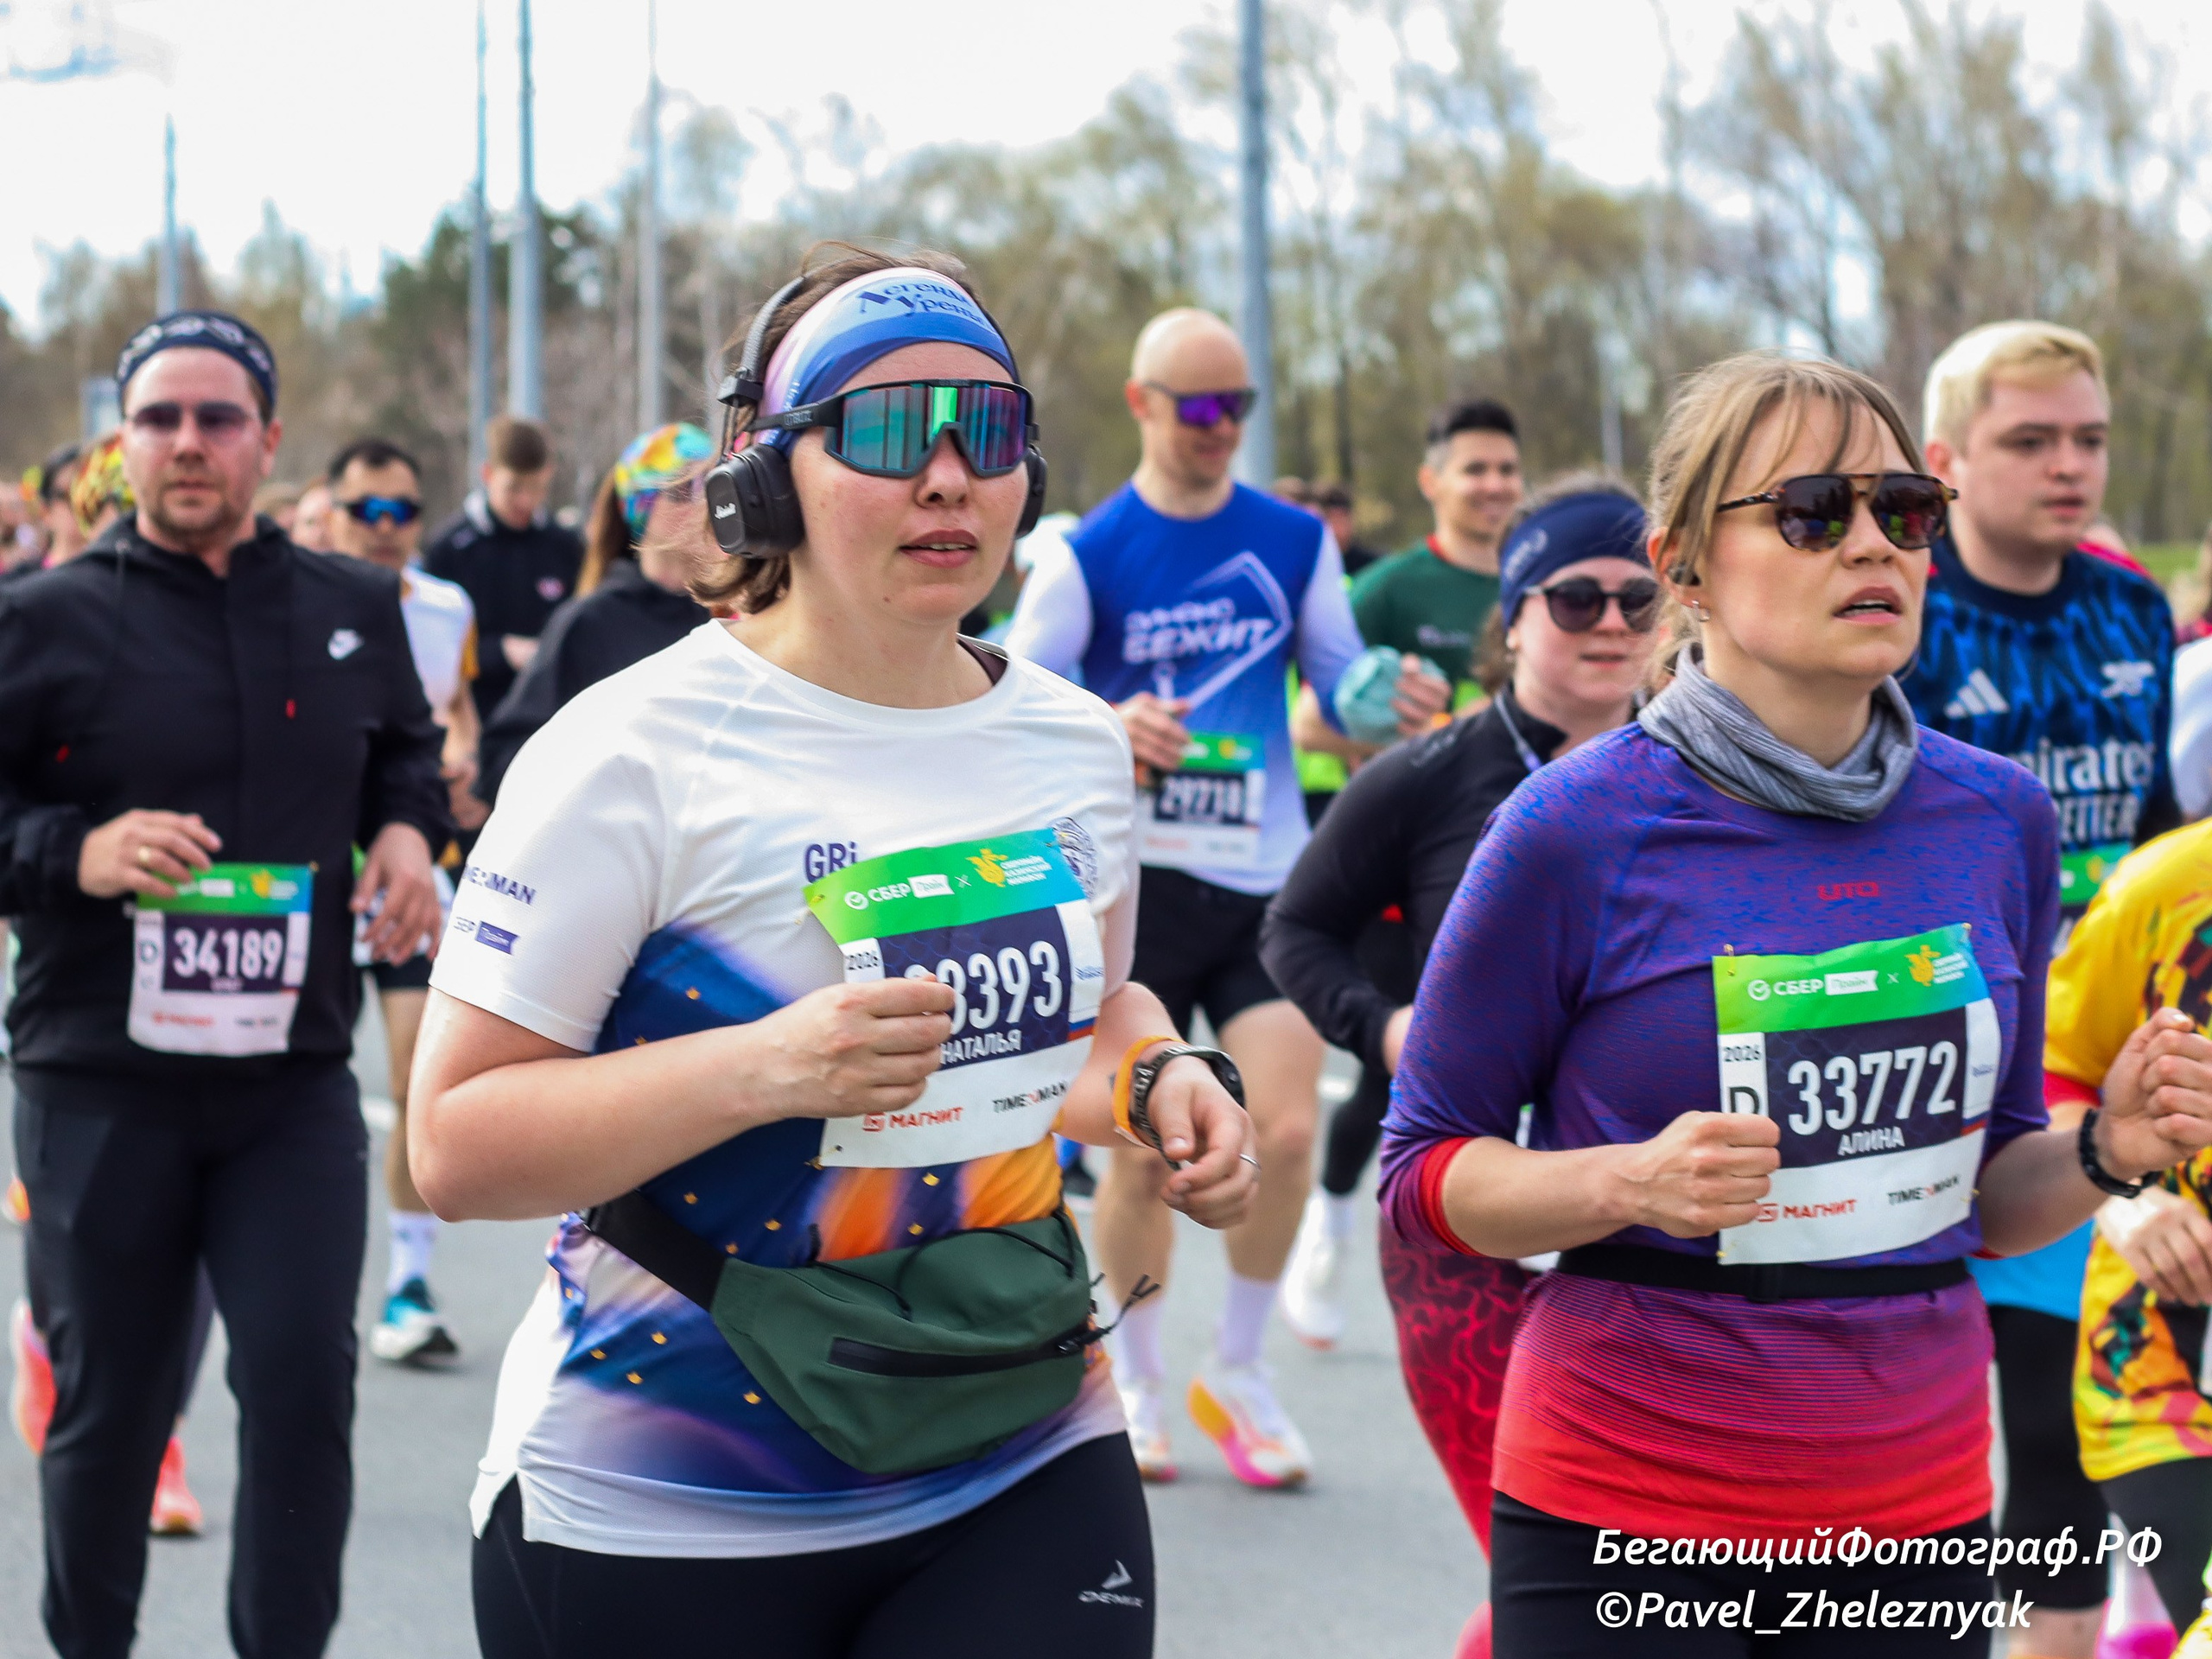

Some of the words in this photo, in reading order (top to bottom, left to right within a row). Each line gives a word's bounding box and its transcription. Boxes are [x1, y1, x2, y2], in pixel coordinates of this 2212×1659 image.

[2053, 794, 2140, 845] ETTER
[868, 882, 911, 902] СБЕР
[1817, 881, 1879, 900] UTO
[174, 927, 283, 979] 34189
[904, 940, 1064, 1035] 3393
[1773, 978, 1825, 995] СБЕР
[940, 1028, 1023, 1065] НАТАЛЬЯ
[1723, 1043, 1762, 1063] 2026
[1727, 1085, 1760, 1116] D
[1787, 1040, 1959, 1136] 33772
[889, 1107, 964, 1128] МАГНИТ
[1837, 1126, 1906, 1156] АЛИНА
[1783, 1198, 1858, 1220] МАГНИТ
